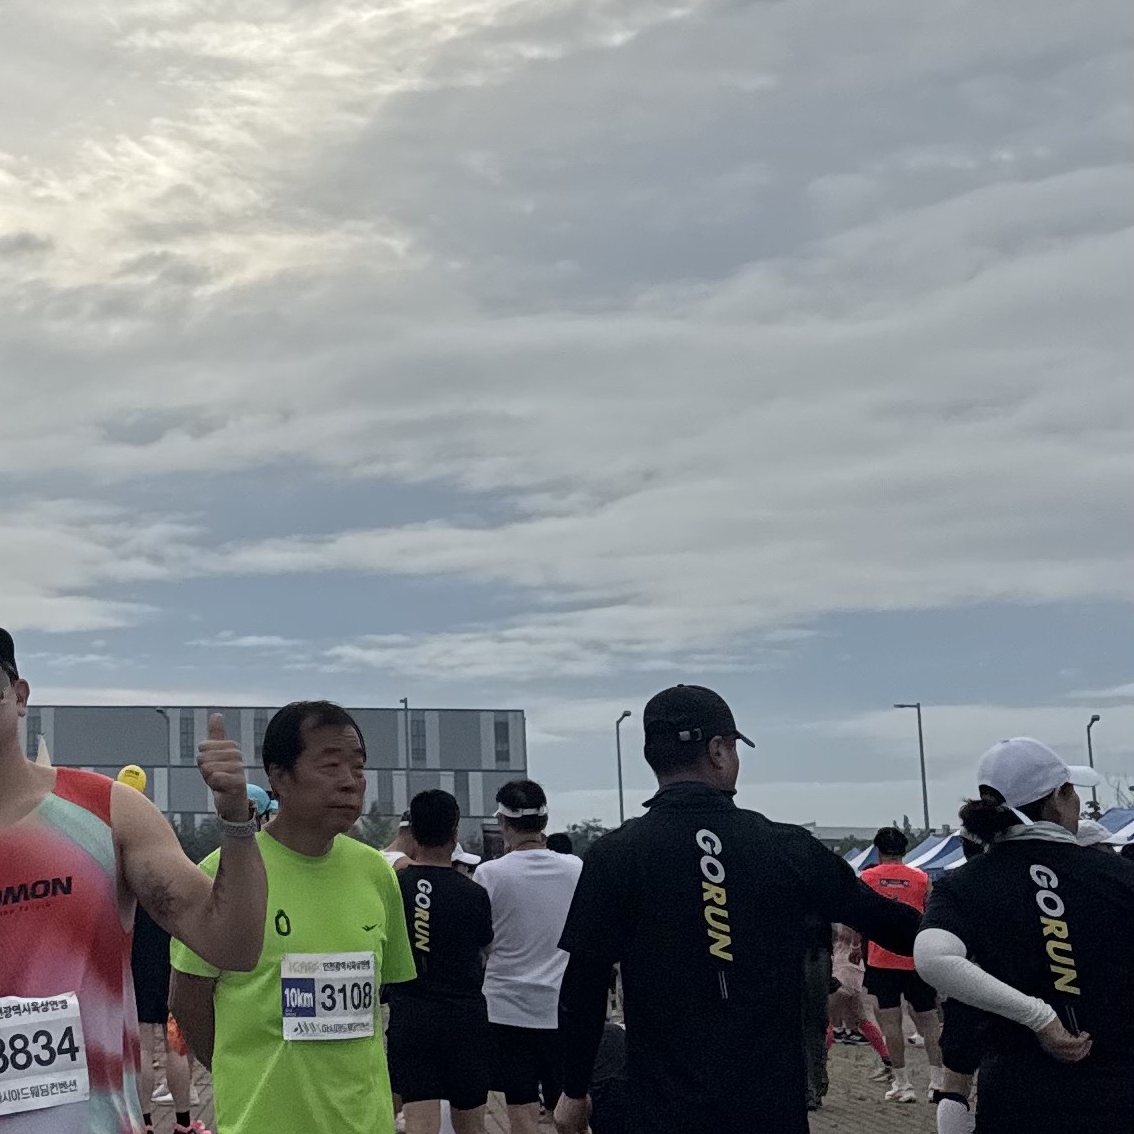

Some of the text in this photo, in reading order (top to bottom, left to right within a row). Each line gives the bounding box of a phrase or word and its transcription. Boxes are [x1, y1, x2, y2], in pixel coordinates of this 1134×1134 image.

[413, 878, 433, 953] GORUN
[695, 828, 734, 962] GORUN
[1029, 864, 1081, 995] GORUN
[284, 981, 372, 1012] 10km 3108
